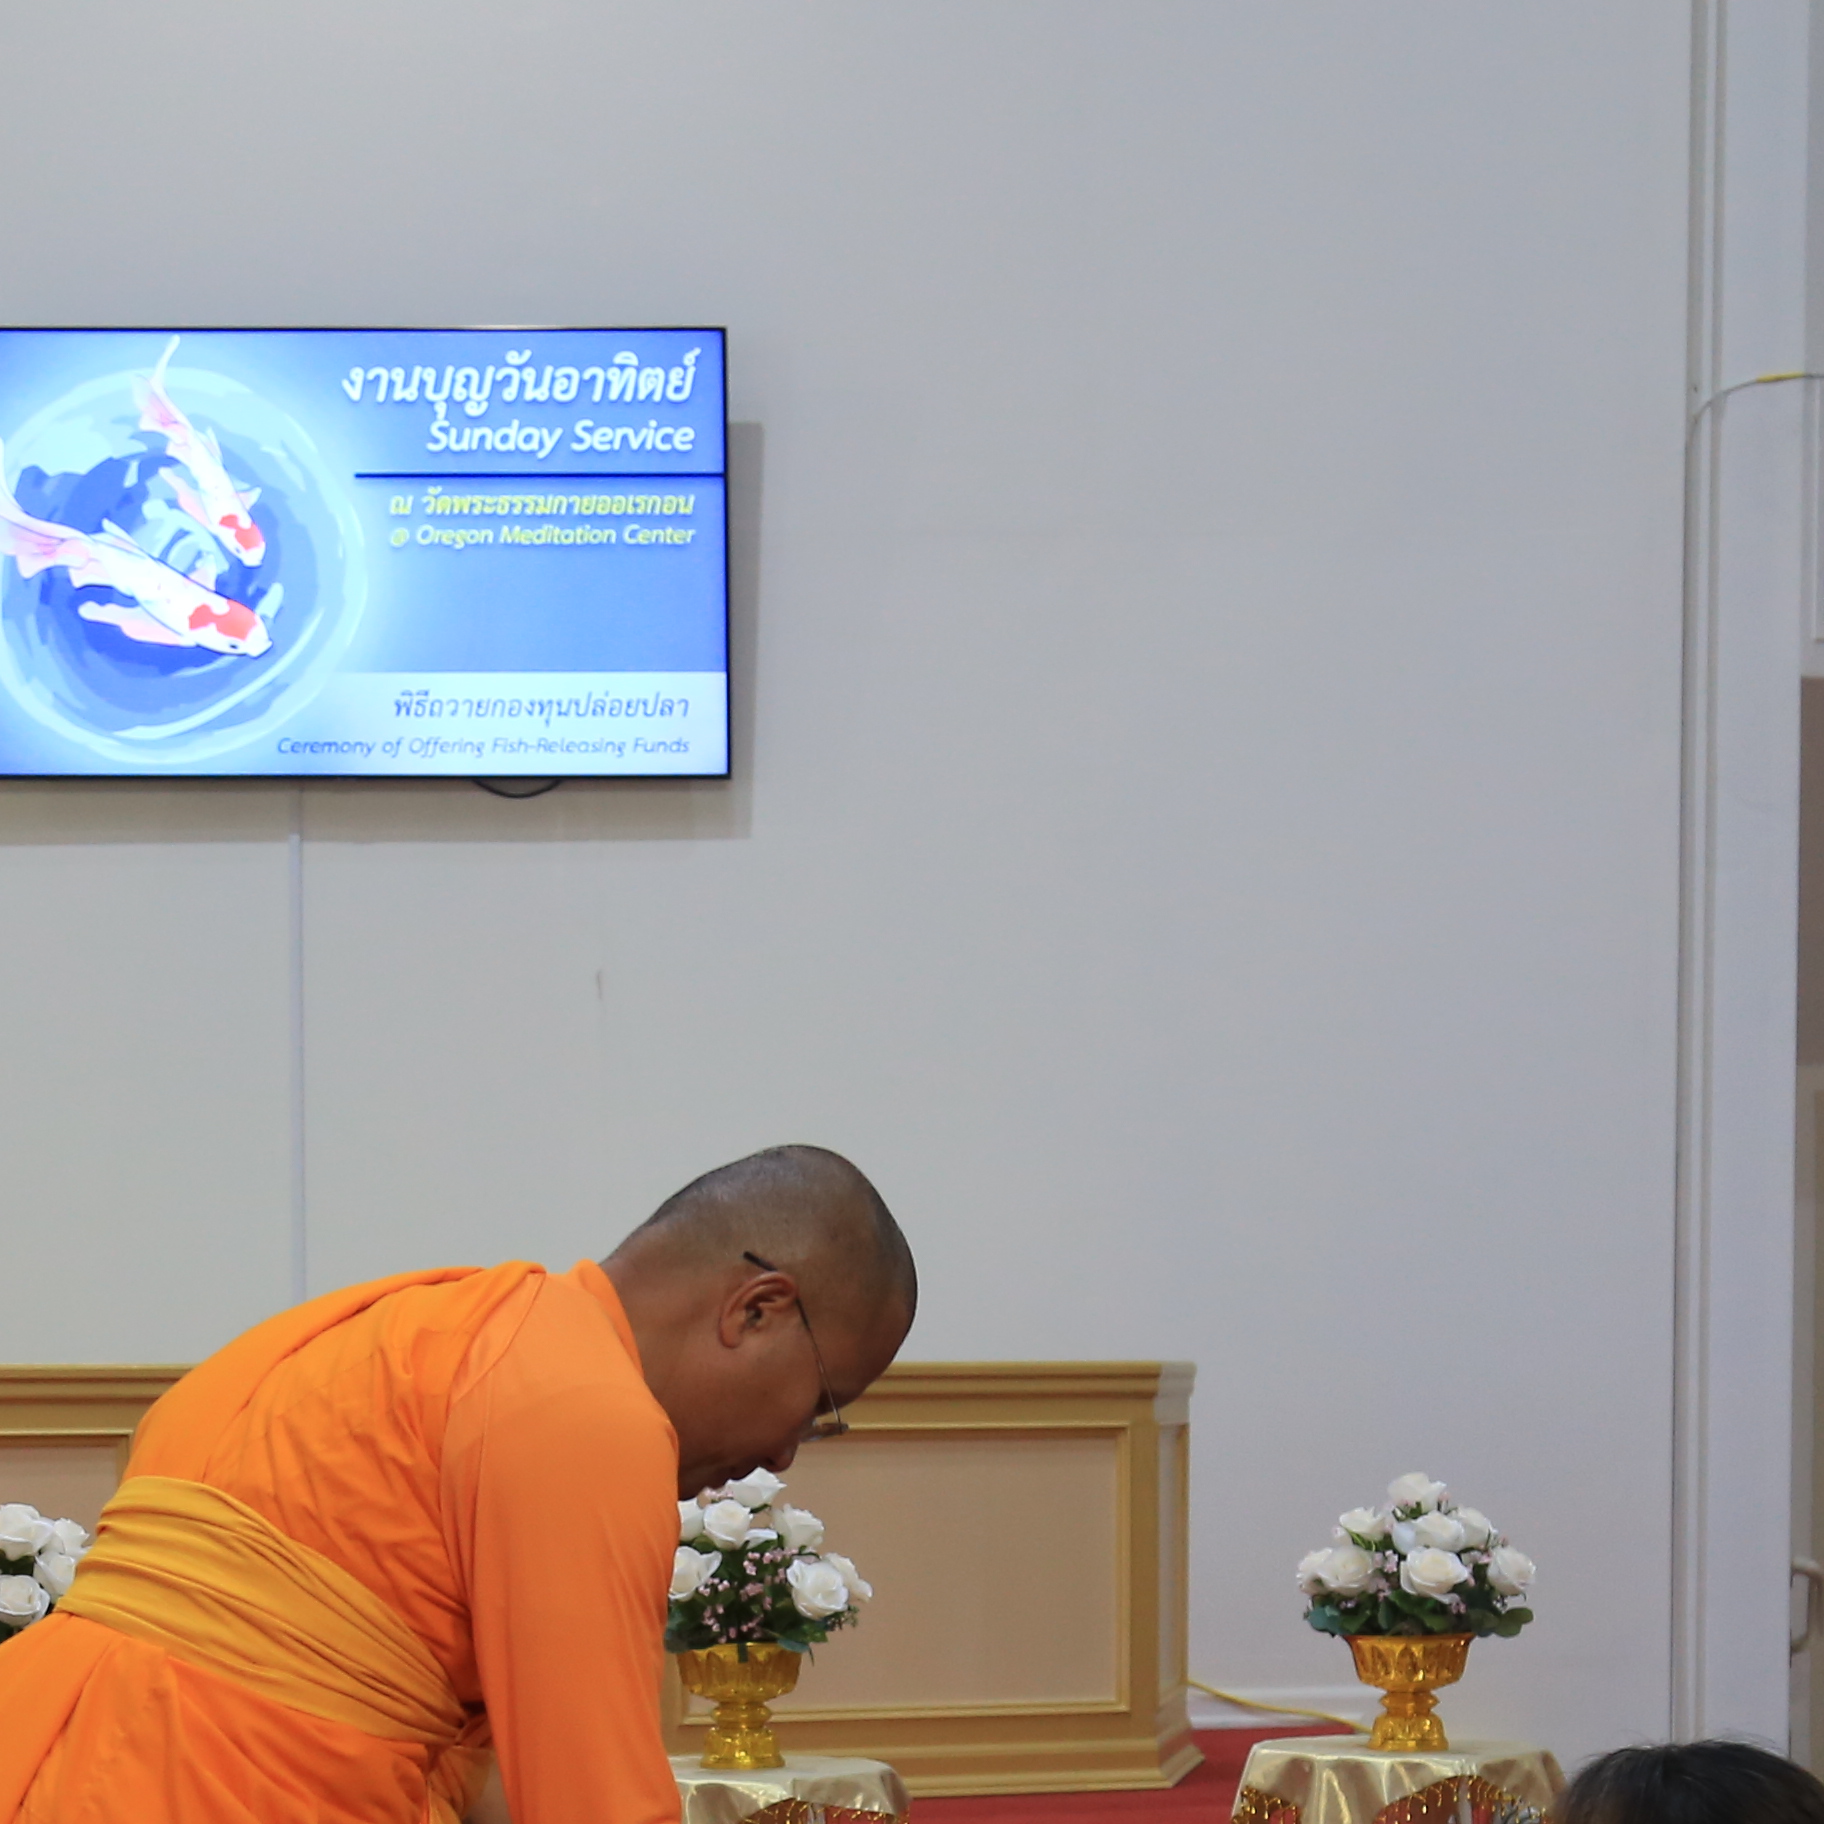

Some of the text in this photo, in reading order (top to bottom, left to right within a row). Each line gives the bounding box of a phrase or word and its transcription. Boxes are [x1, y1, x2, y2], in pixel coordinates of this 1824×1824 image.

[341, 348, 702, 420] งานบุญวันอาทิตย์
[426, 418, 696, 460] Sunday Service
[416, 525, 494, 550] Oregon
[499, 523, 617, 545] Meditation
[622, 524, 696, 545] Center
[393, 688, 690, 727] พิธีถวายกองทุนปล่อยปลา
[277, 736, 691, 759] Ceremony of Offering Fish-Releasing Funds
